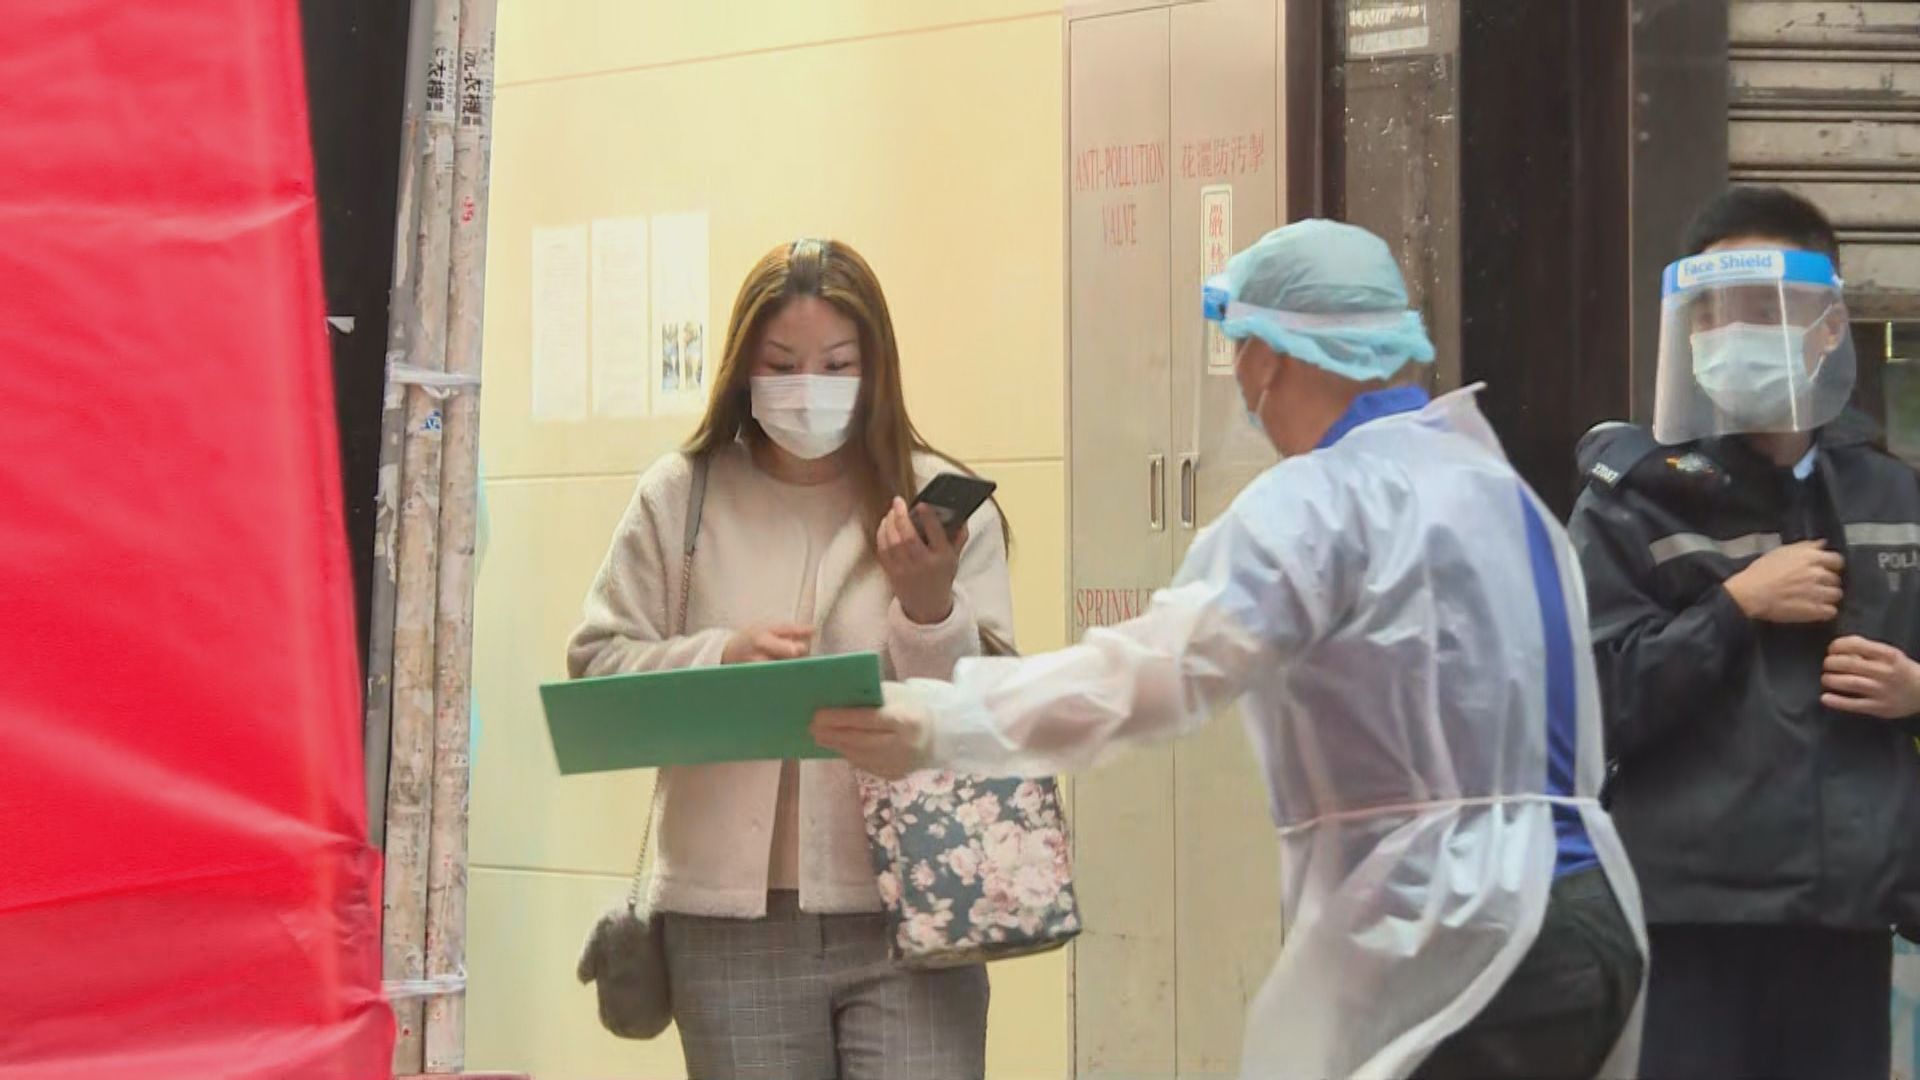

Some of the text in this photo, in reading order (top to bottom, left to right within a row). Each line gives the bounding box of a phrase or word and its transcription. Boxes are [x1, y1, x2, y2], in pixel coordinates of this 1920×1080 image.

[427, 48, 446, 99] 衣機
[1076, 143, 1165, 192] ANTI-POLLUTION
[1102, 203, 1137, 246] VALVE
[1683, 261, 1714, 275] Face
[1719, 254, 1772, 269] Shield
[1877, 549, 1920, 570] POLI
